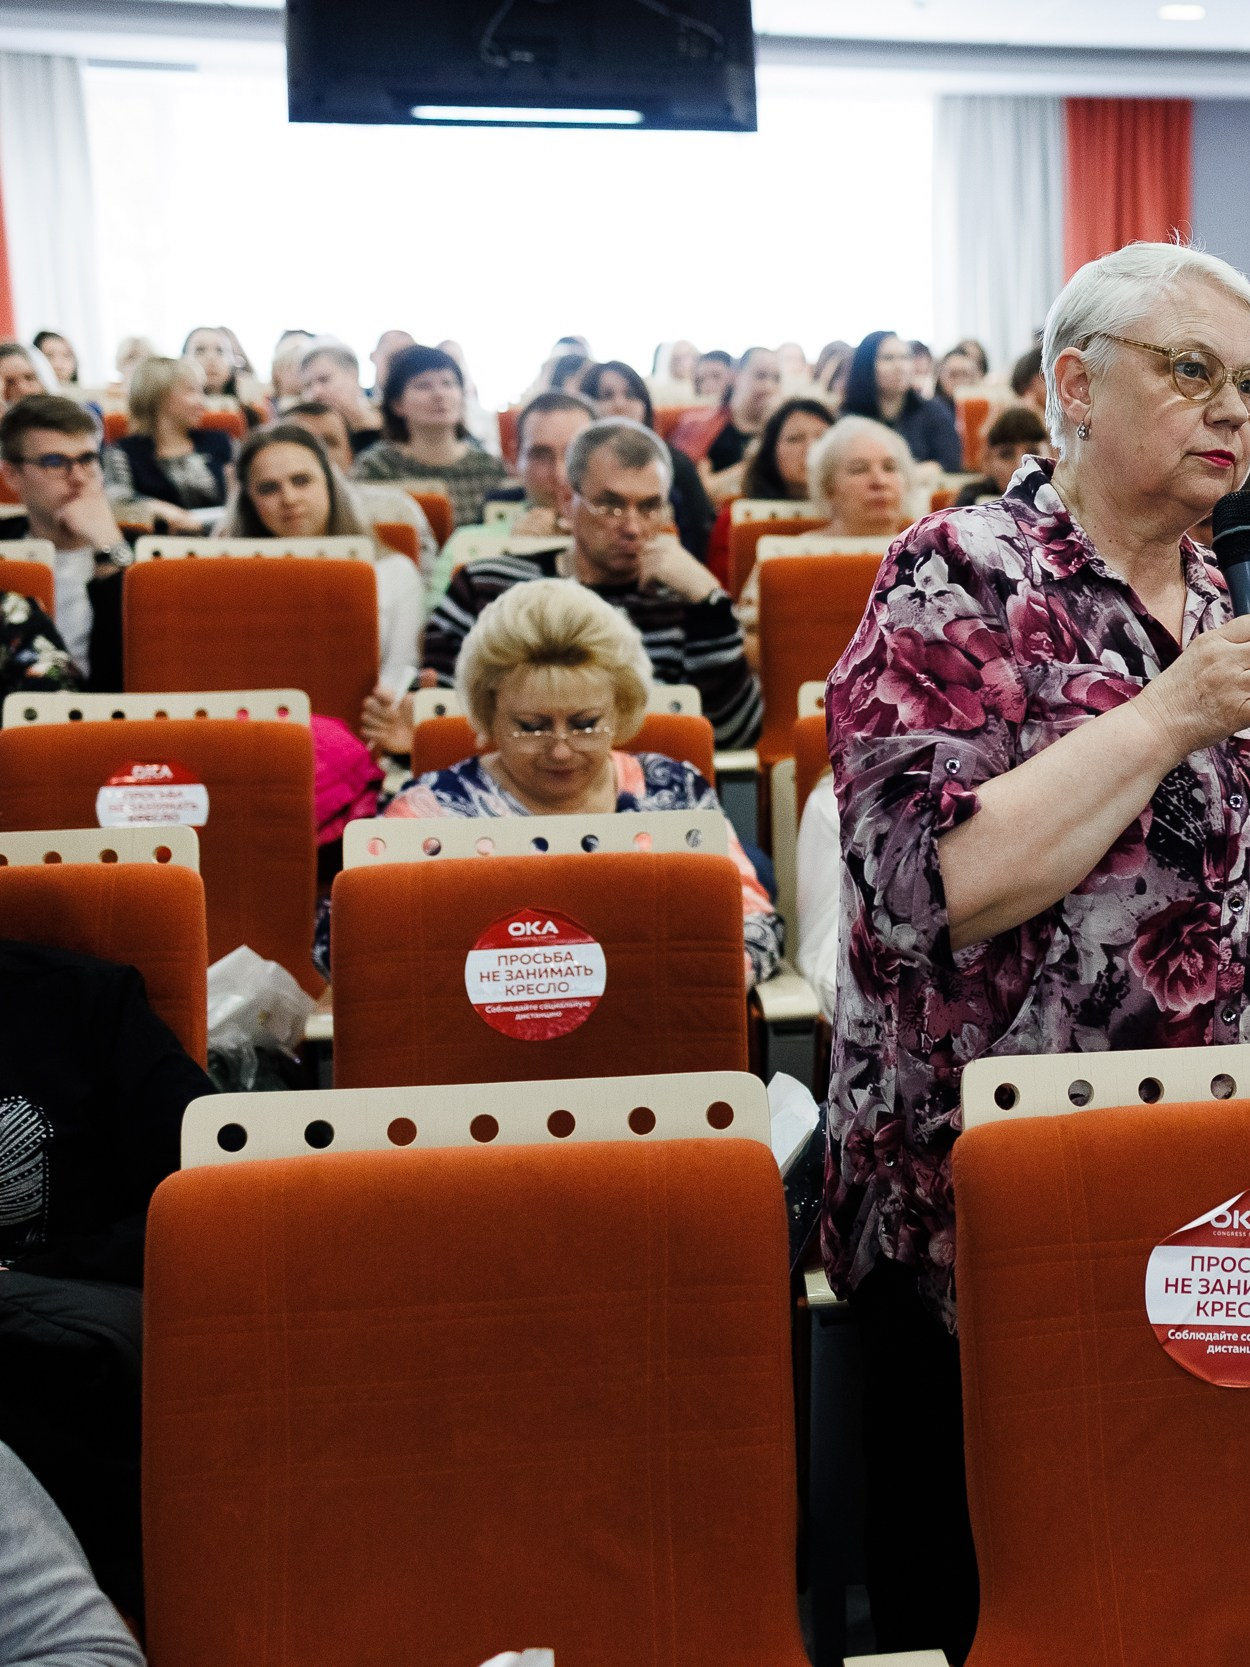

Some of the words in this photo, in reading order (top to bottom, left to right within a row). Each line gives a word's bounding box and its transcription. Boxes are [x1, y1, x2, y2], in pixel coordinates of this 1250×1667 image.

[497, 952, 574, 967] ПРОСЬБА
[480, 970, 500, 983] НЕ
[505, 965, 594, 982] ЗАНИМАТЬ
[505, 982, 570, 997] КРЕСЛО
[1213, 1230, 1246, 1238] CONGRESS
[1164, 1277, 1193, 1294] НЕ
[1167, 1329, 1238, 1342] Соблюдайте
